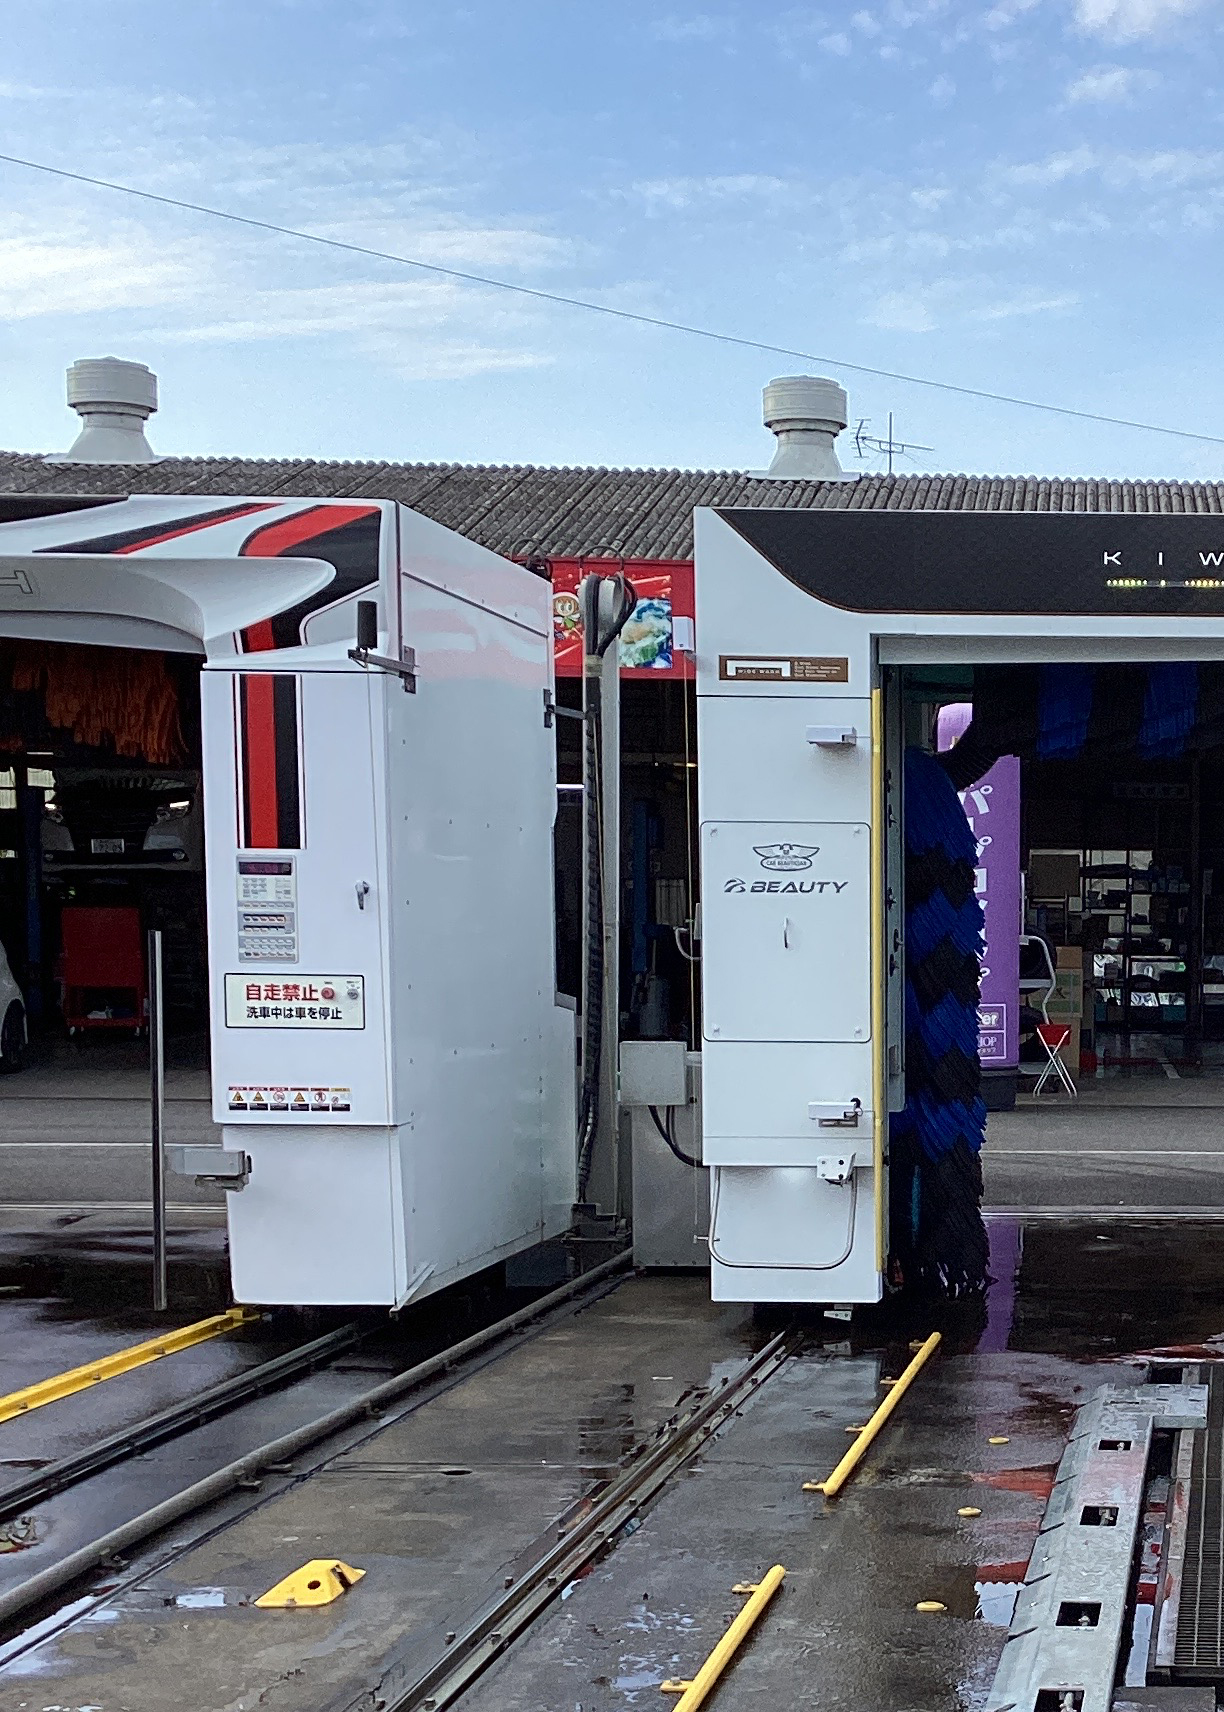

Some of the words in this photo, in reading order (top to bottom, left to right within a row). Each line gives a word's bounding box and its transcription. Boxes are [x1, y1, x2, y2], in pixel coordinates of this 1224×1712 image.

[750, 880, 849, 894] BEAUTY
[245, 983, 319, 1002] 自走禁止
[246, 1005, 343, 1020] 洗車中は車を停止
